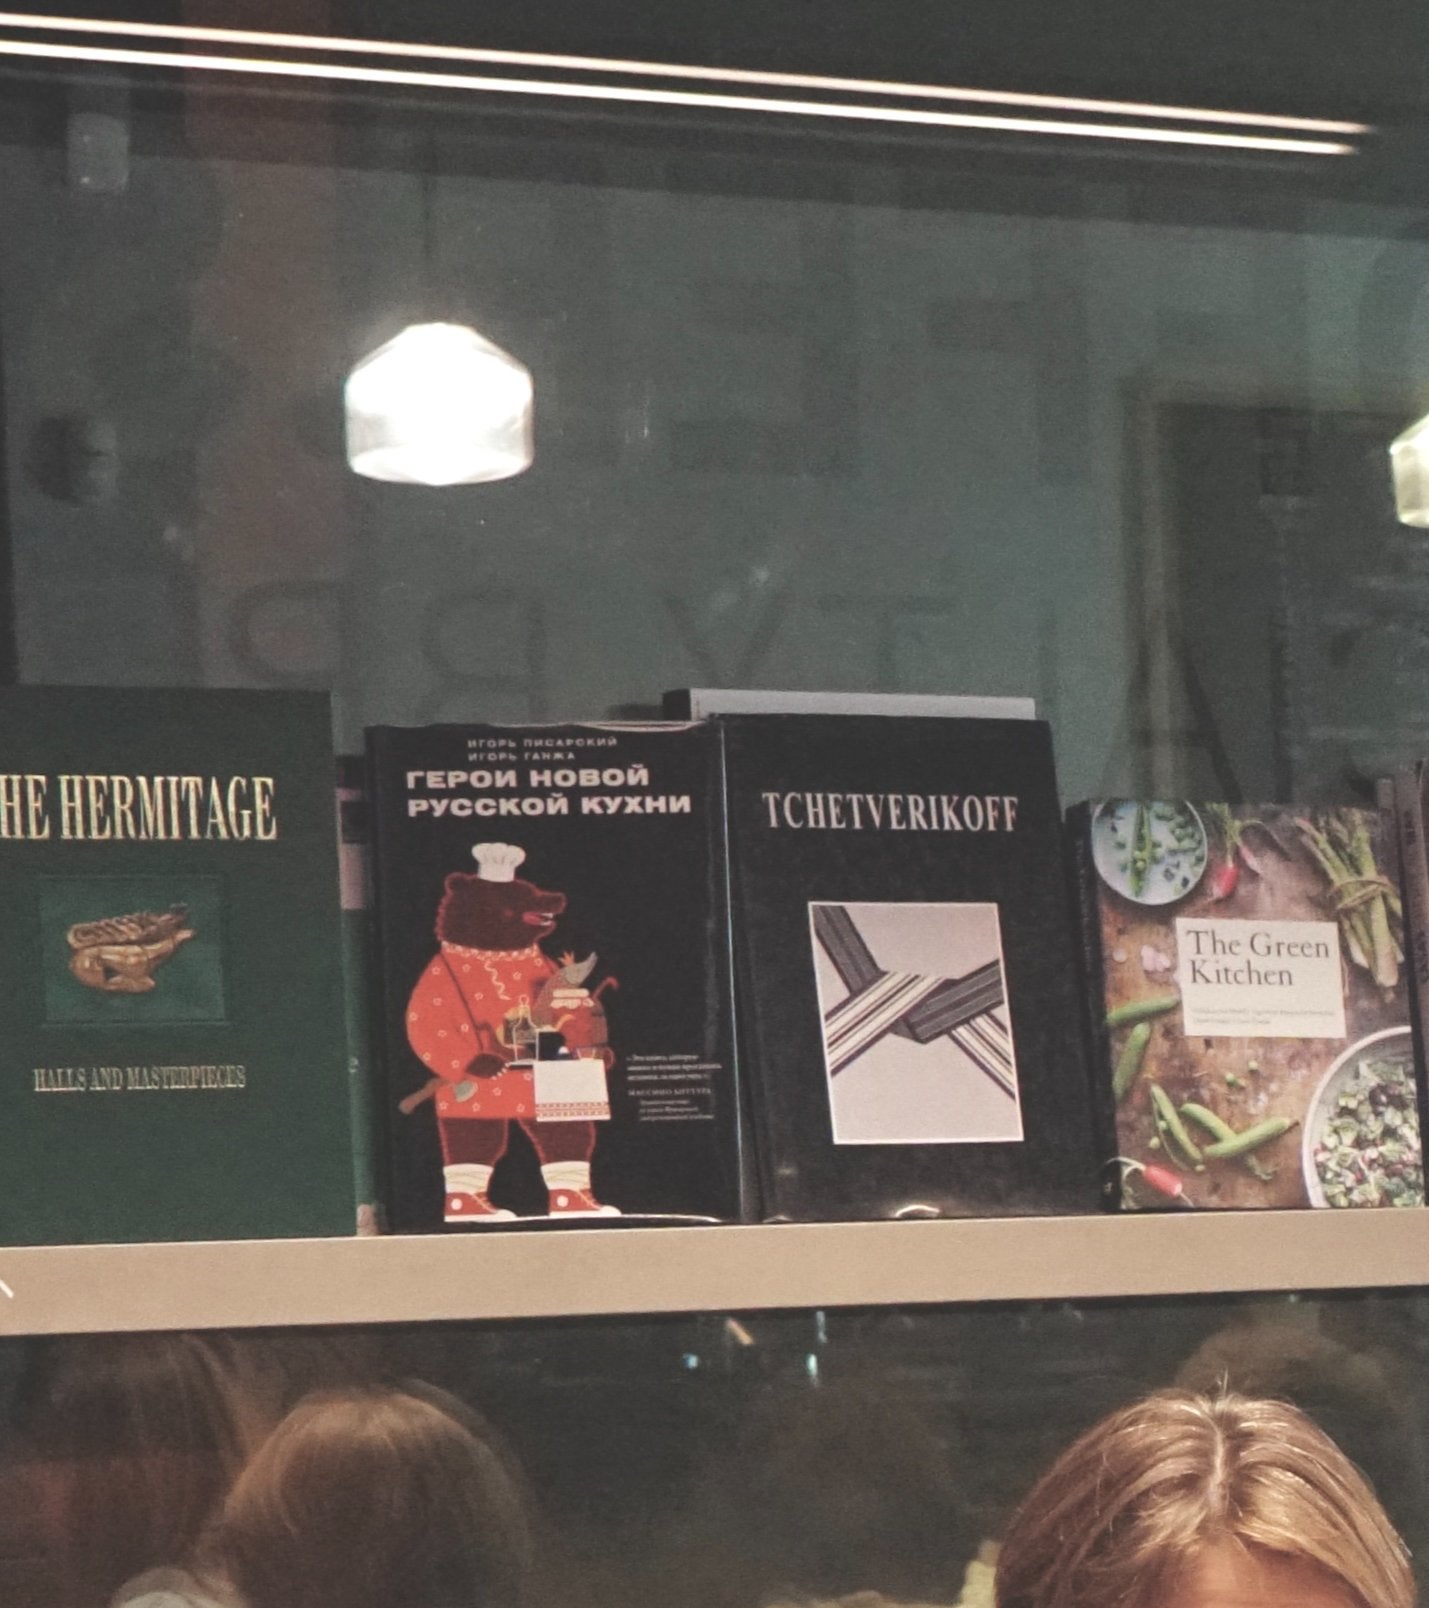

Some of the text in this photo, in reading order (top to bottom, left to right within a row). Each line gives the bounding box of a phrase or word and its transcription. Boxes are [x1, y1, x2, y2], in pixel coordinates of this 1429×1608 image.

[468, 735, 618, 748] ИГОРЬ ПИСАРСКИЙ
[468, 751, 576, 761] ИГОРЬ ГАНЖА
[406, 763, 650, 789] ГЕРОИ НОВОЙ
[0, 774, 278, 842] HE HERMITAGE
[407, 791, 692, 818] РУССКОЙ КУХНИ
[761, 790, 1019, 832] TCHETVERIKOFF
[1185, 928, 1330, 958] The Green
[1189, 958, 1294, 986] Kitchen
[34, 1064, 246, 1092] HALLS AND MASTERPIECES
